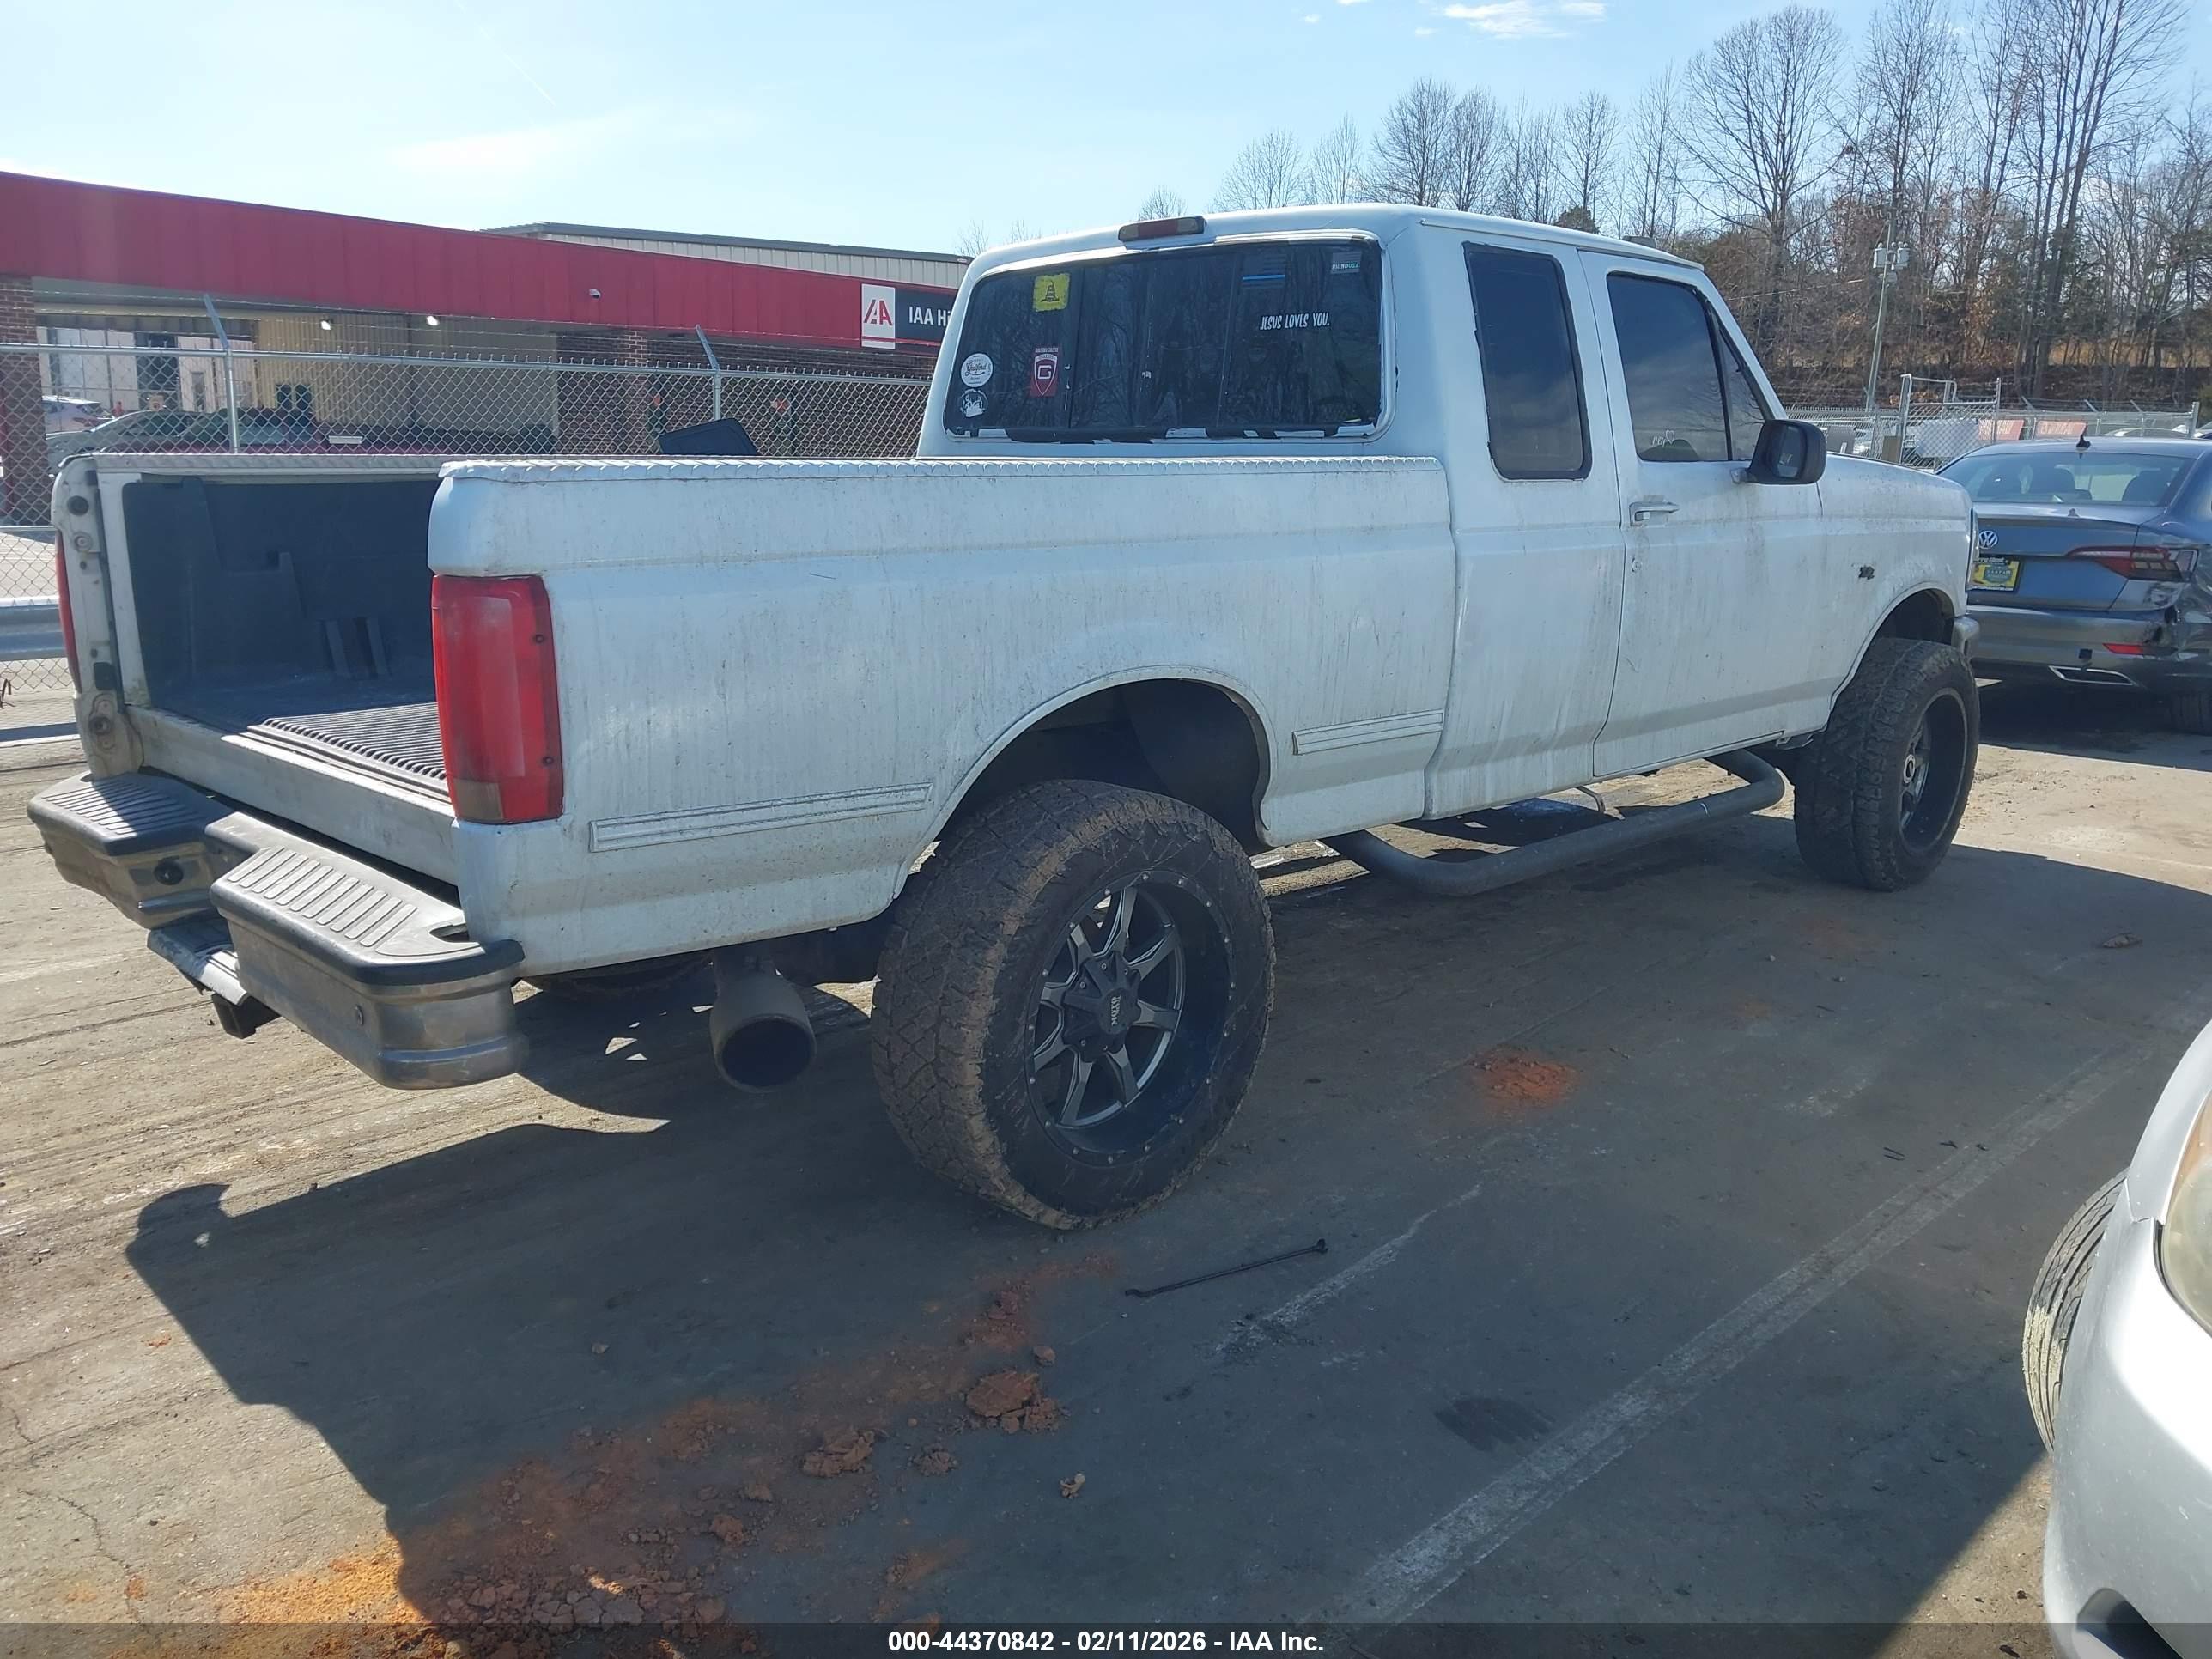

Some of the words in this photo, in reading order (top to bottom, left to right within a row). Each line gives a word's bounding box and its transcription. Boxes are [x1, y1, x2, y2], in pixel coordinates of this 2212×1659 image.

[908, 306, 933, 325] IAA
[1260, 315, 1283, 331] JESUS
[1285, 313, 1309, 328] LOVES
[1312, 313, 1330, 326] YOU.
